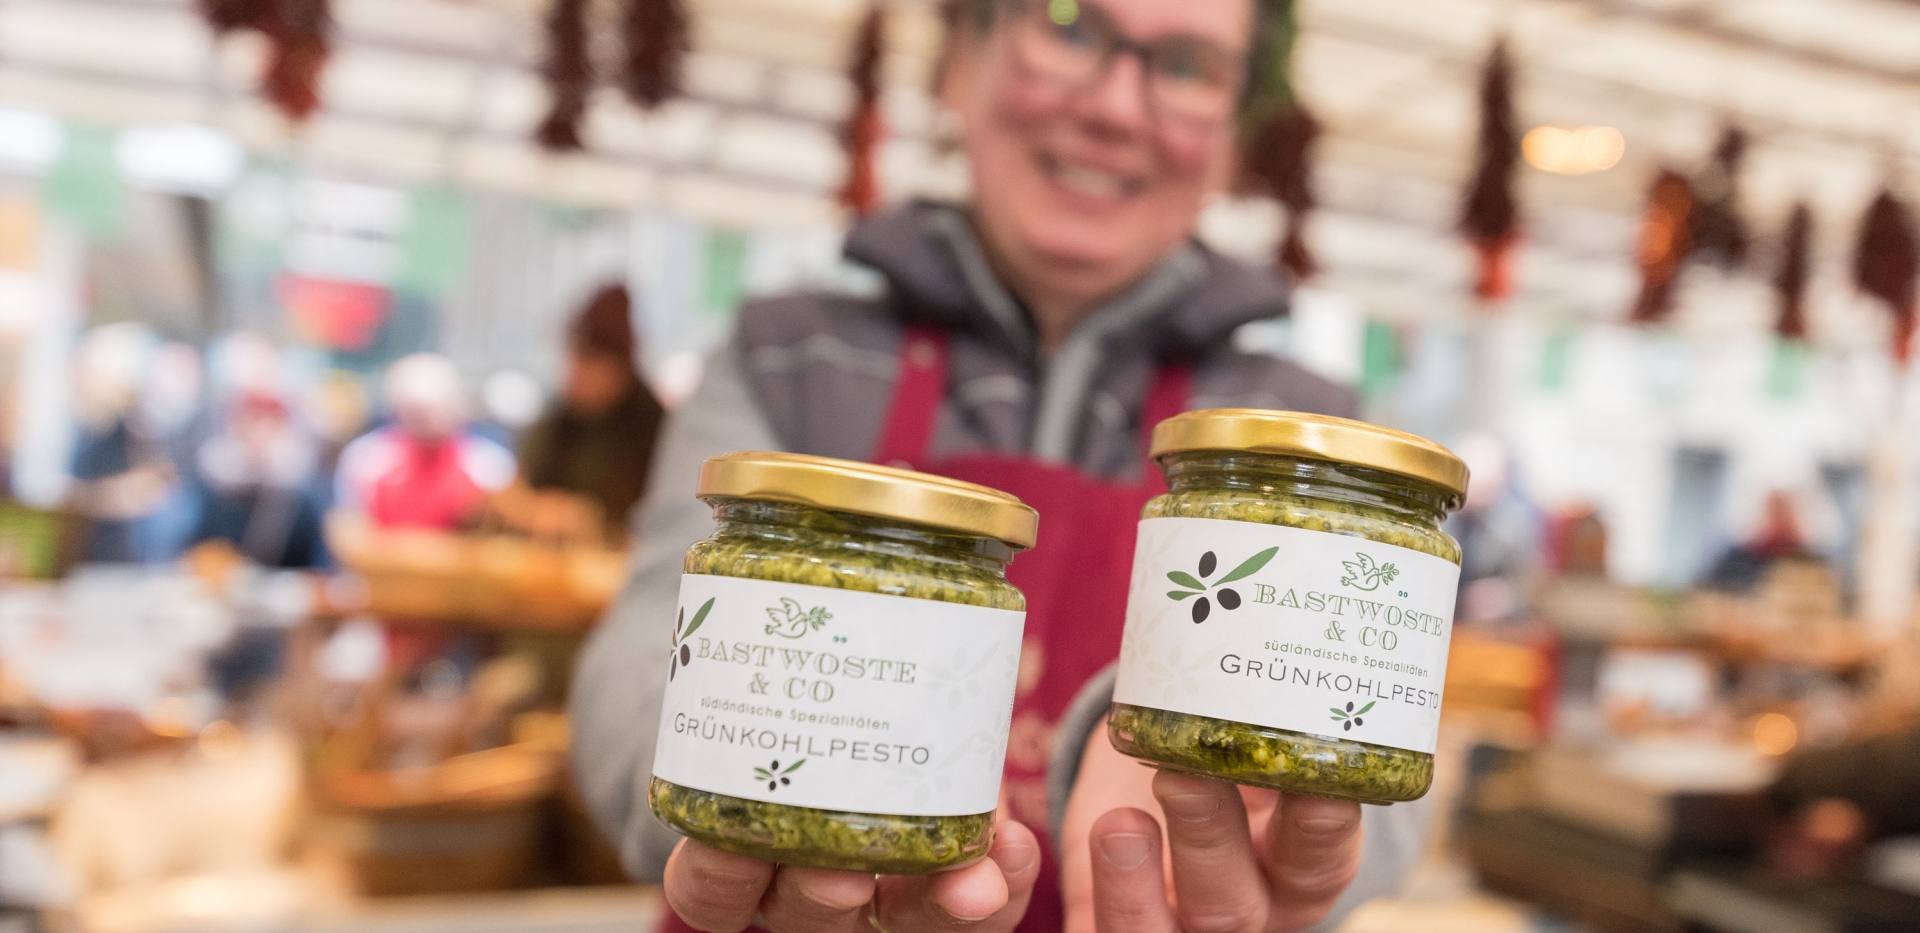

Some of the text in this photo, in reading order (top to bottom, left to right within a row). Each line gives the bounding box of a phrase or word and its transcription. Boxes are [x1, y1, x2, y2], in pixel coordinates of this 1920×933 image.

[1323, 620, 1398, 651] & CO
[1264, 640, 1429, 678] südländische Spezialitäten
[747, 672, 835, 703] & CO
[1220, 654, 1440, 709] GRÜNKOHLPESTO
[700, 697, 891, 731] südländische Spezialitäten
[674, 712, 931, 766] GRÜNKOHLPESTO
